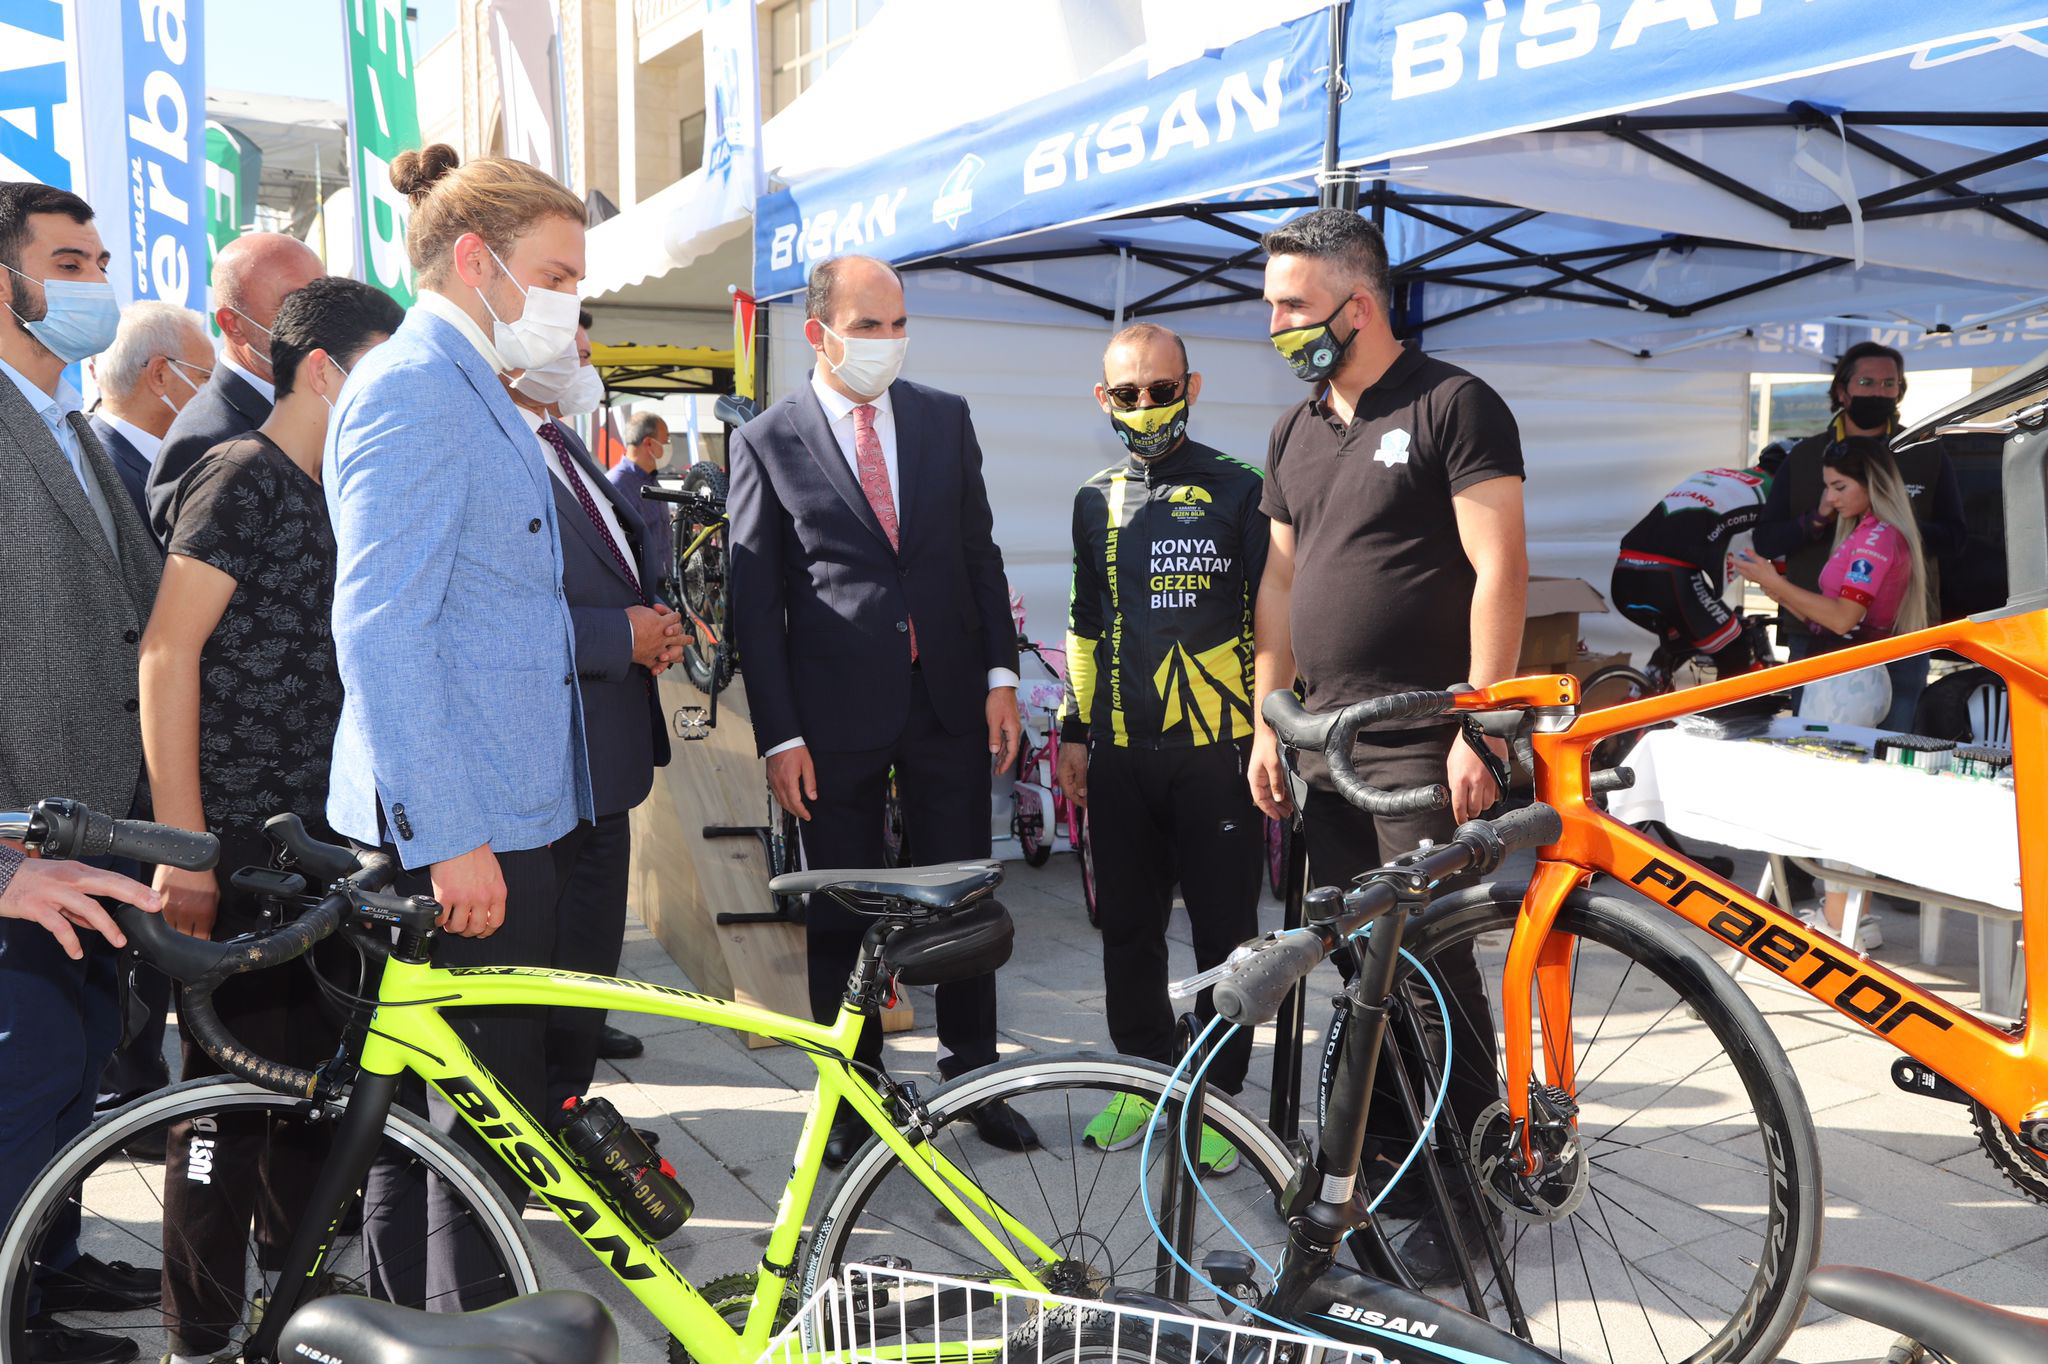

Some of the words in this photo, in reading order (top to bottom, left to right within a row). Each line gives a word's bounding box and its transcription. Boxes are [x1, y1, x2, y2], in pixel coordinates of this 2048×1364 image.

[130, 156, 147, 295] osman
[1106, 529, 1119, 562] BİLİR
[1151, 539, 1217, 556] KONYA
[1150, 557, 1232, 573] KARATAY
[1150, 574, 1211, 591] GEZEN
[1151, 589, 1197, 609] BİLİR
[192, 1112, 219, 1132] D
[187, 1136, 215, 1185] JUST
[604, 1150, 668, 1219] WIGNS
